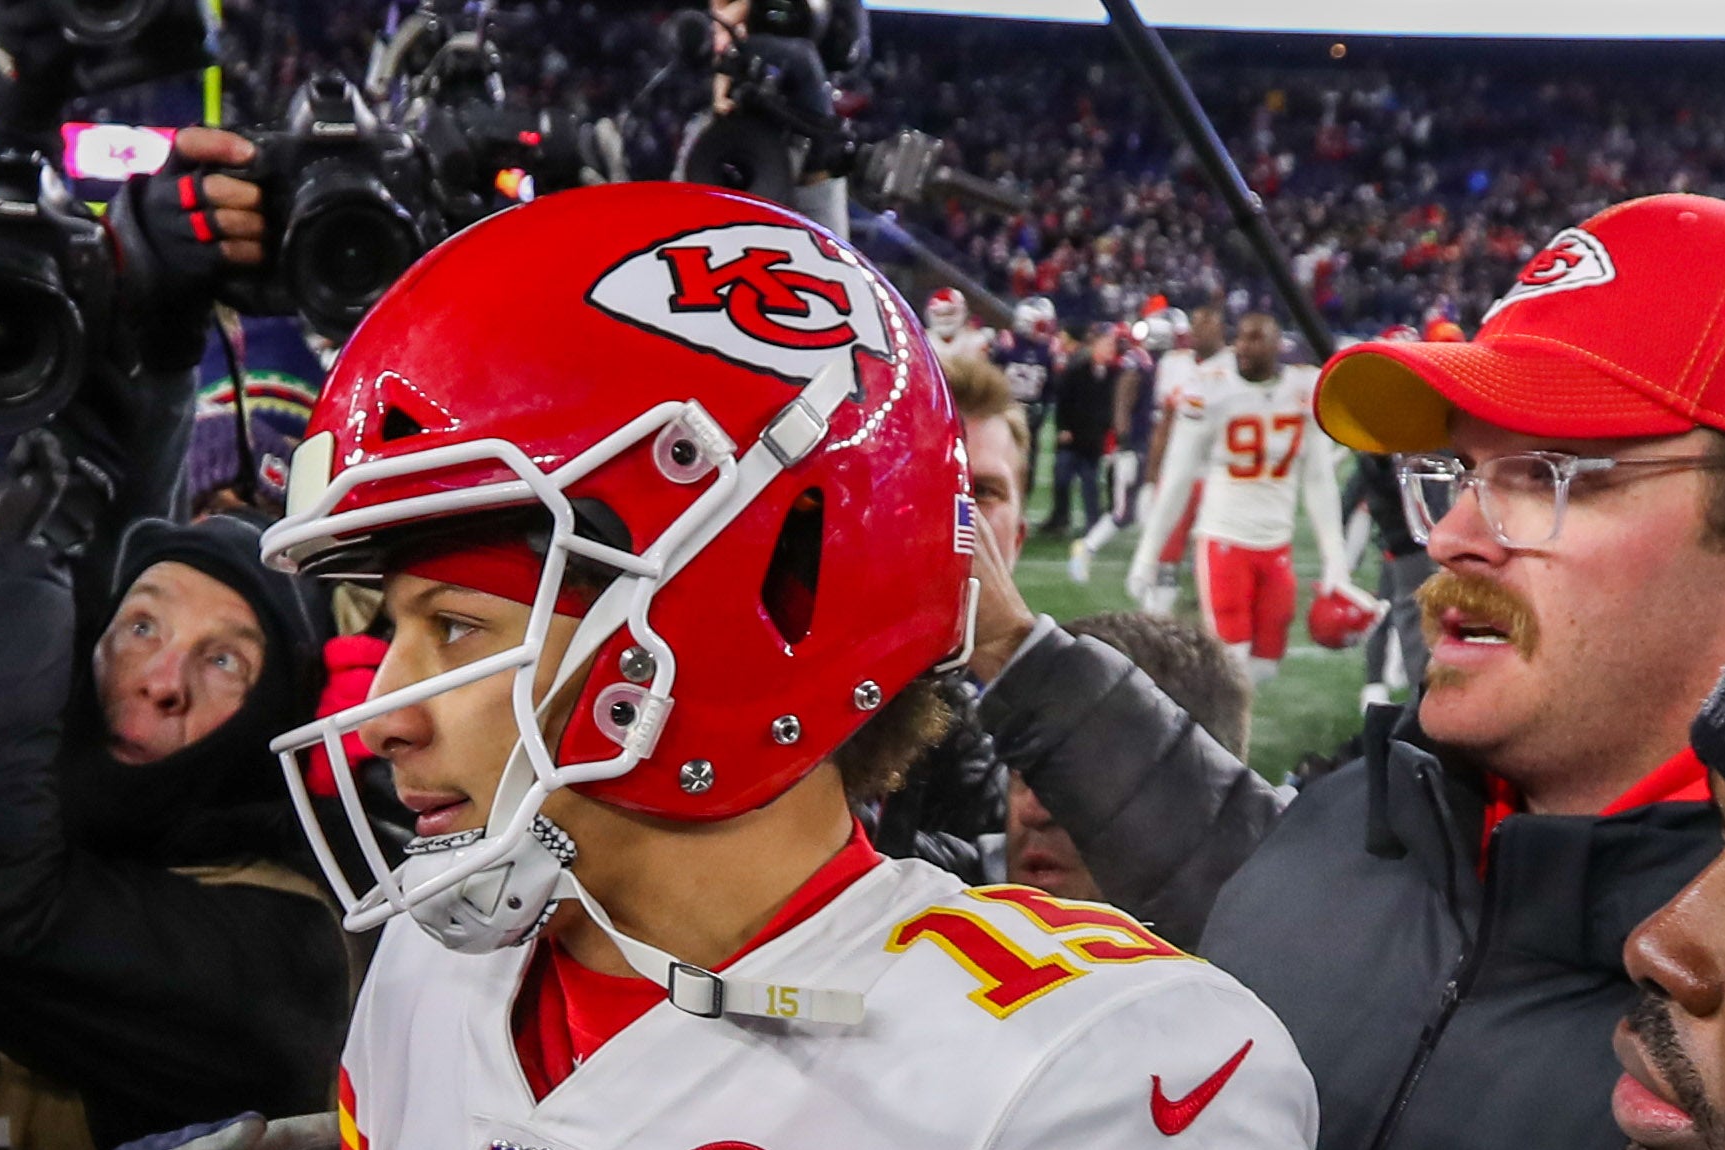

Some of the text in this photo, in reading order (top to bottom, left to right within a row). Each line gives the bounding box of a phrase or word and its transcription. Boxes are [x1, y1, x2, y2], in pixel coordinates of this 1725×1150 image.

[656, 246, 858, 350] KC
[1227, 413, 1304, 479] 97
[884, 884, 1206, 1019] 15
[766, 984, 799, 1018] 15
